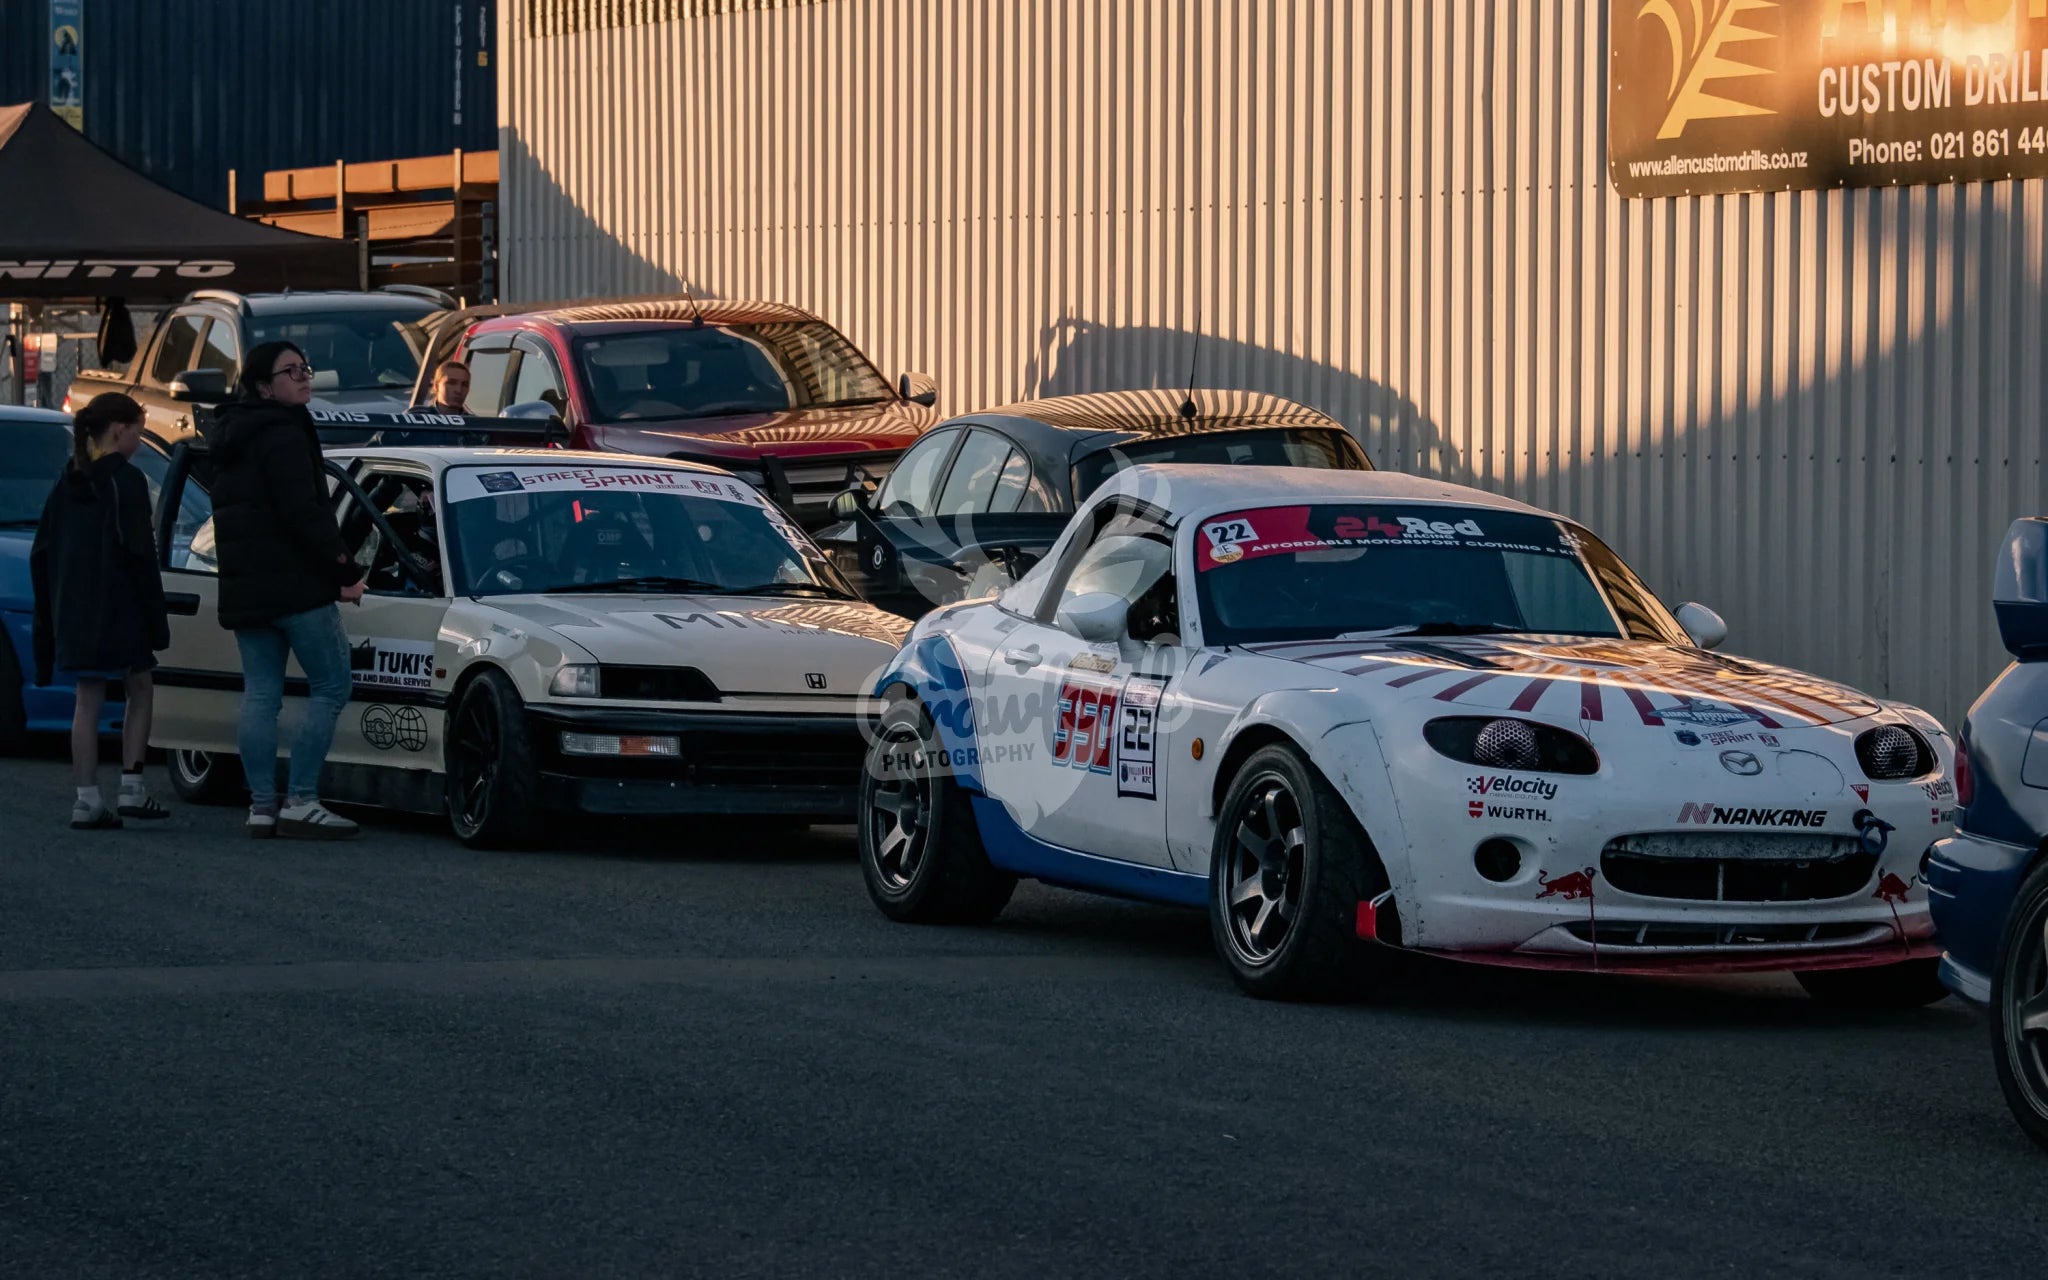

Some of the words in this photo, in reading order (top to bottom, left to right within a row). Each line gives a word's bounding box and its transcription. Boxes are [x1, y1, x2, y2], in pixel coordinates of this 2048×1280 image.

[1818, 58, 1951, 118] CUSTOM
[1849, 137, 1922, 165] Phone:
[1930, 132, 1965, 160] 021
[1972, 129, 2009, 158] 861
[2017, 126, 2048, 155] 44
[1629, 150, 1808, 178] www.allencustomdrills.co.nz
[0, 259, 236, 279] NITTO
[310, 410, 370, 423] UKIS
[384, 413, 466, 426] TILING
[521, 469, 594, 485] STREET
[581, 474, 674, 489] SPRINT
[1211, 523, 1251, 543] 22
[1334, 516, 1485, 538] 24Red
[1251, 539, 1353, 552] AFFORDABLE
[1465, 541, 1542, 551] CLOTHING
[378, 651, 434, 677] TUKI'S
[362, 674, 378, 683] AND
[378, 675, 403, 686] RURAL
[1123, 708, 1152, 752] 22
[1701, 730, 1734, 740] STREET
[1710, 733, 1756, 746] SPRINT
[1479, 775, 1558, 800] Velocity
[1853, 784, 1869, 792] TOW
[1712, 807, 1828, 827] NANKANG
